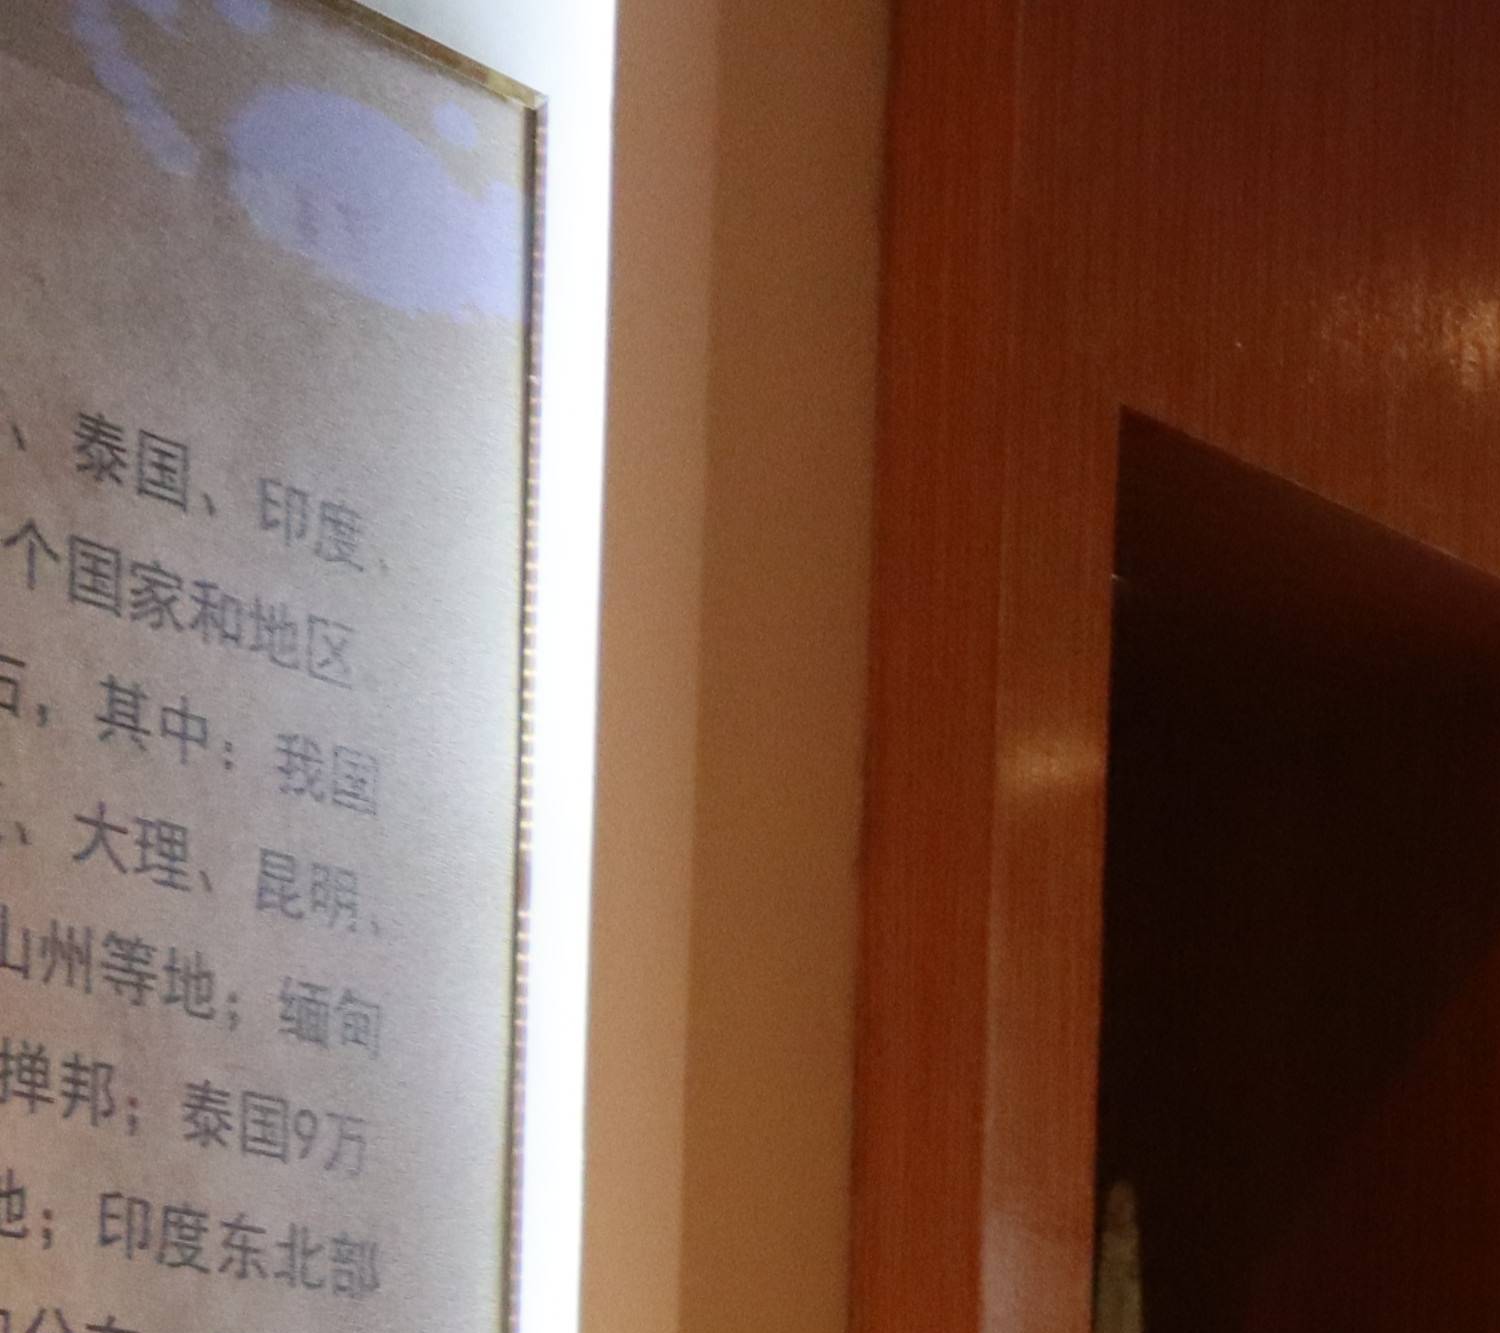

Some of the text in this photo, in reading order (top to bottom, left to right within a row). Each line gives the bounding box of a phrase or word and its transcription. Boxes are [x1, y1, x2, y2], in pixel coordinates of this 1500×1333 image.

[3, 519, 353, 688] 个国家和地区
